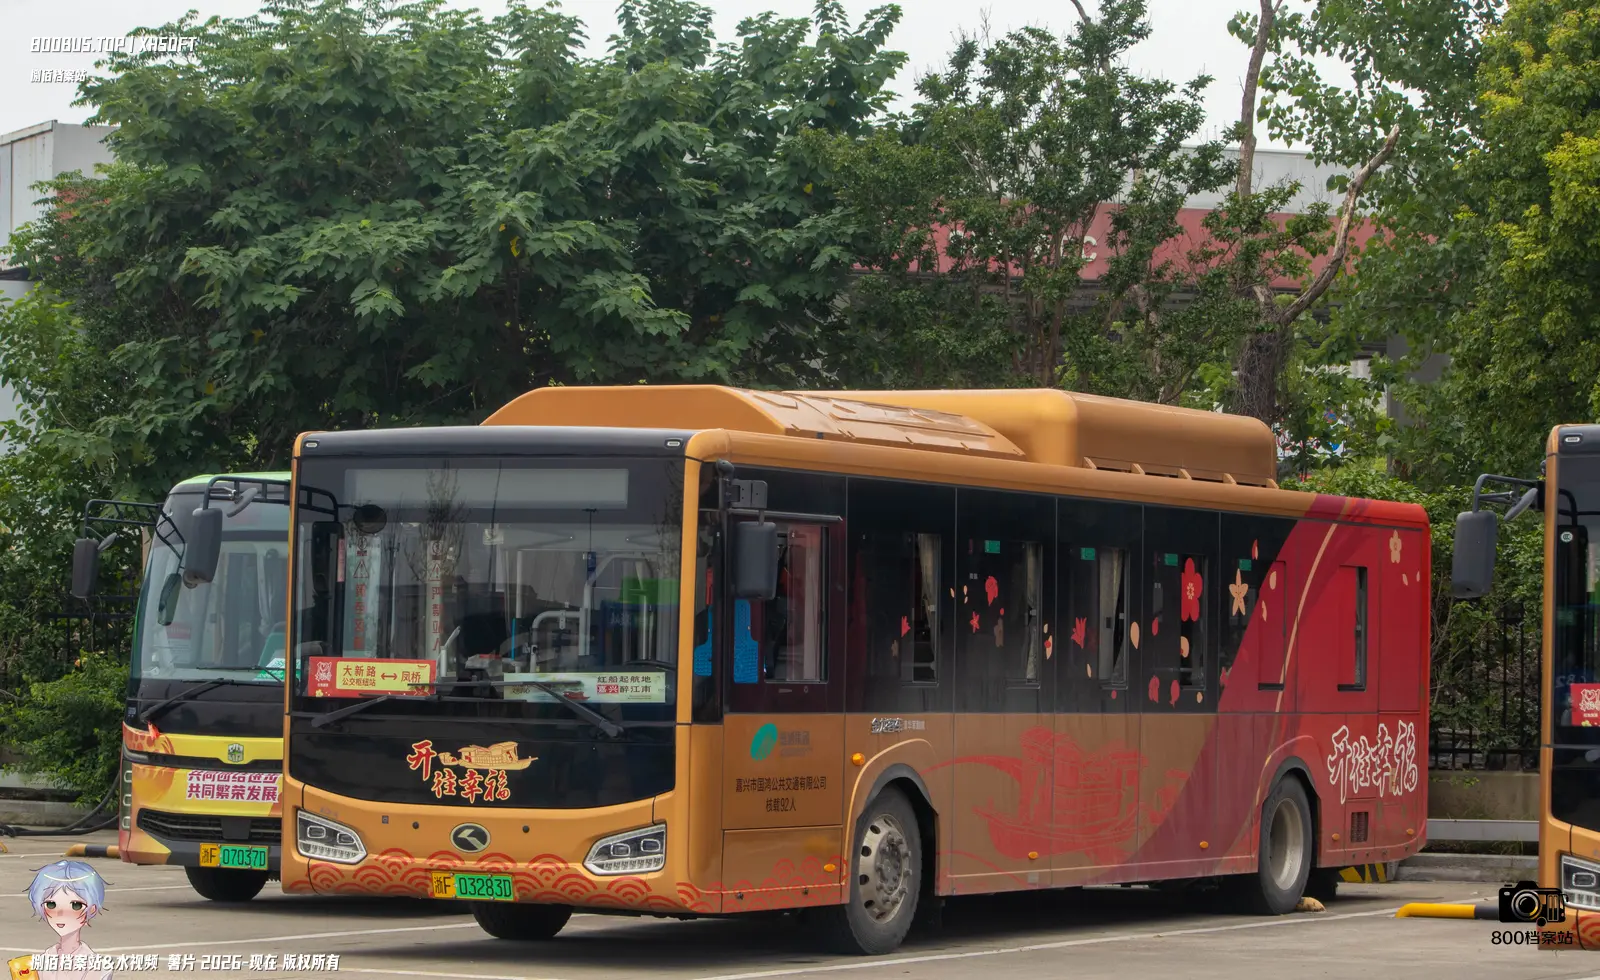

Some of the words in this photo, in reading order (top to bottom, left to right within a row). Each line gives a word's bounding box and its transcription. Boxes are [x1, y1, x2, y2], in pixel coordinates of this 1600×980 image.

[343, 665, 376, 677] 大新路
[401, 671, 421, 683] 凤桥
[597, 675, 652, 684] 红船起航地
[342, 678, 376, 687] 公交枢纽站
[187, 784, 279, 801] 共同繁荣发展
[735, 776, 827, 793] 嘉兴市国鸿公共交通有限公司
[765, 797, 797, 813] 核载92人
